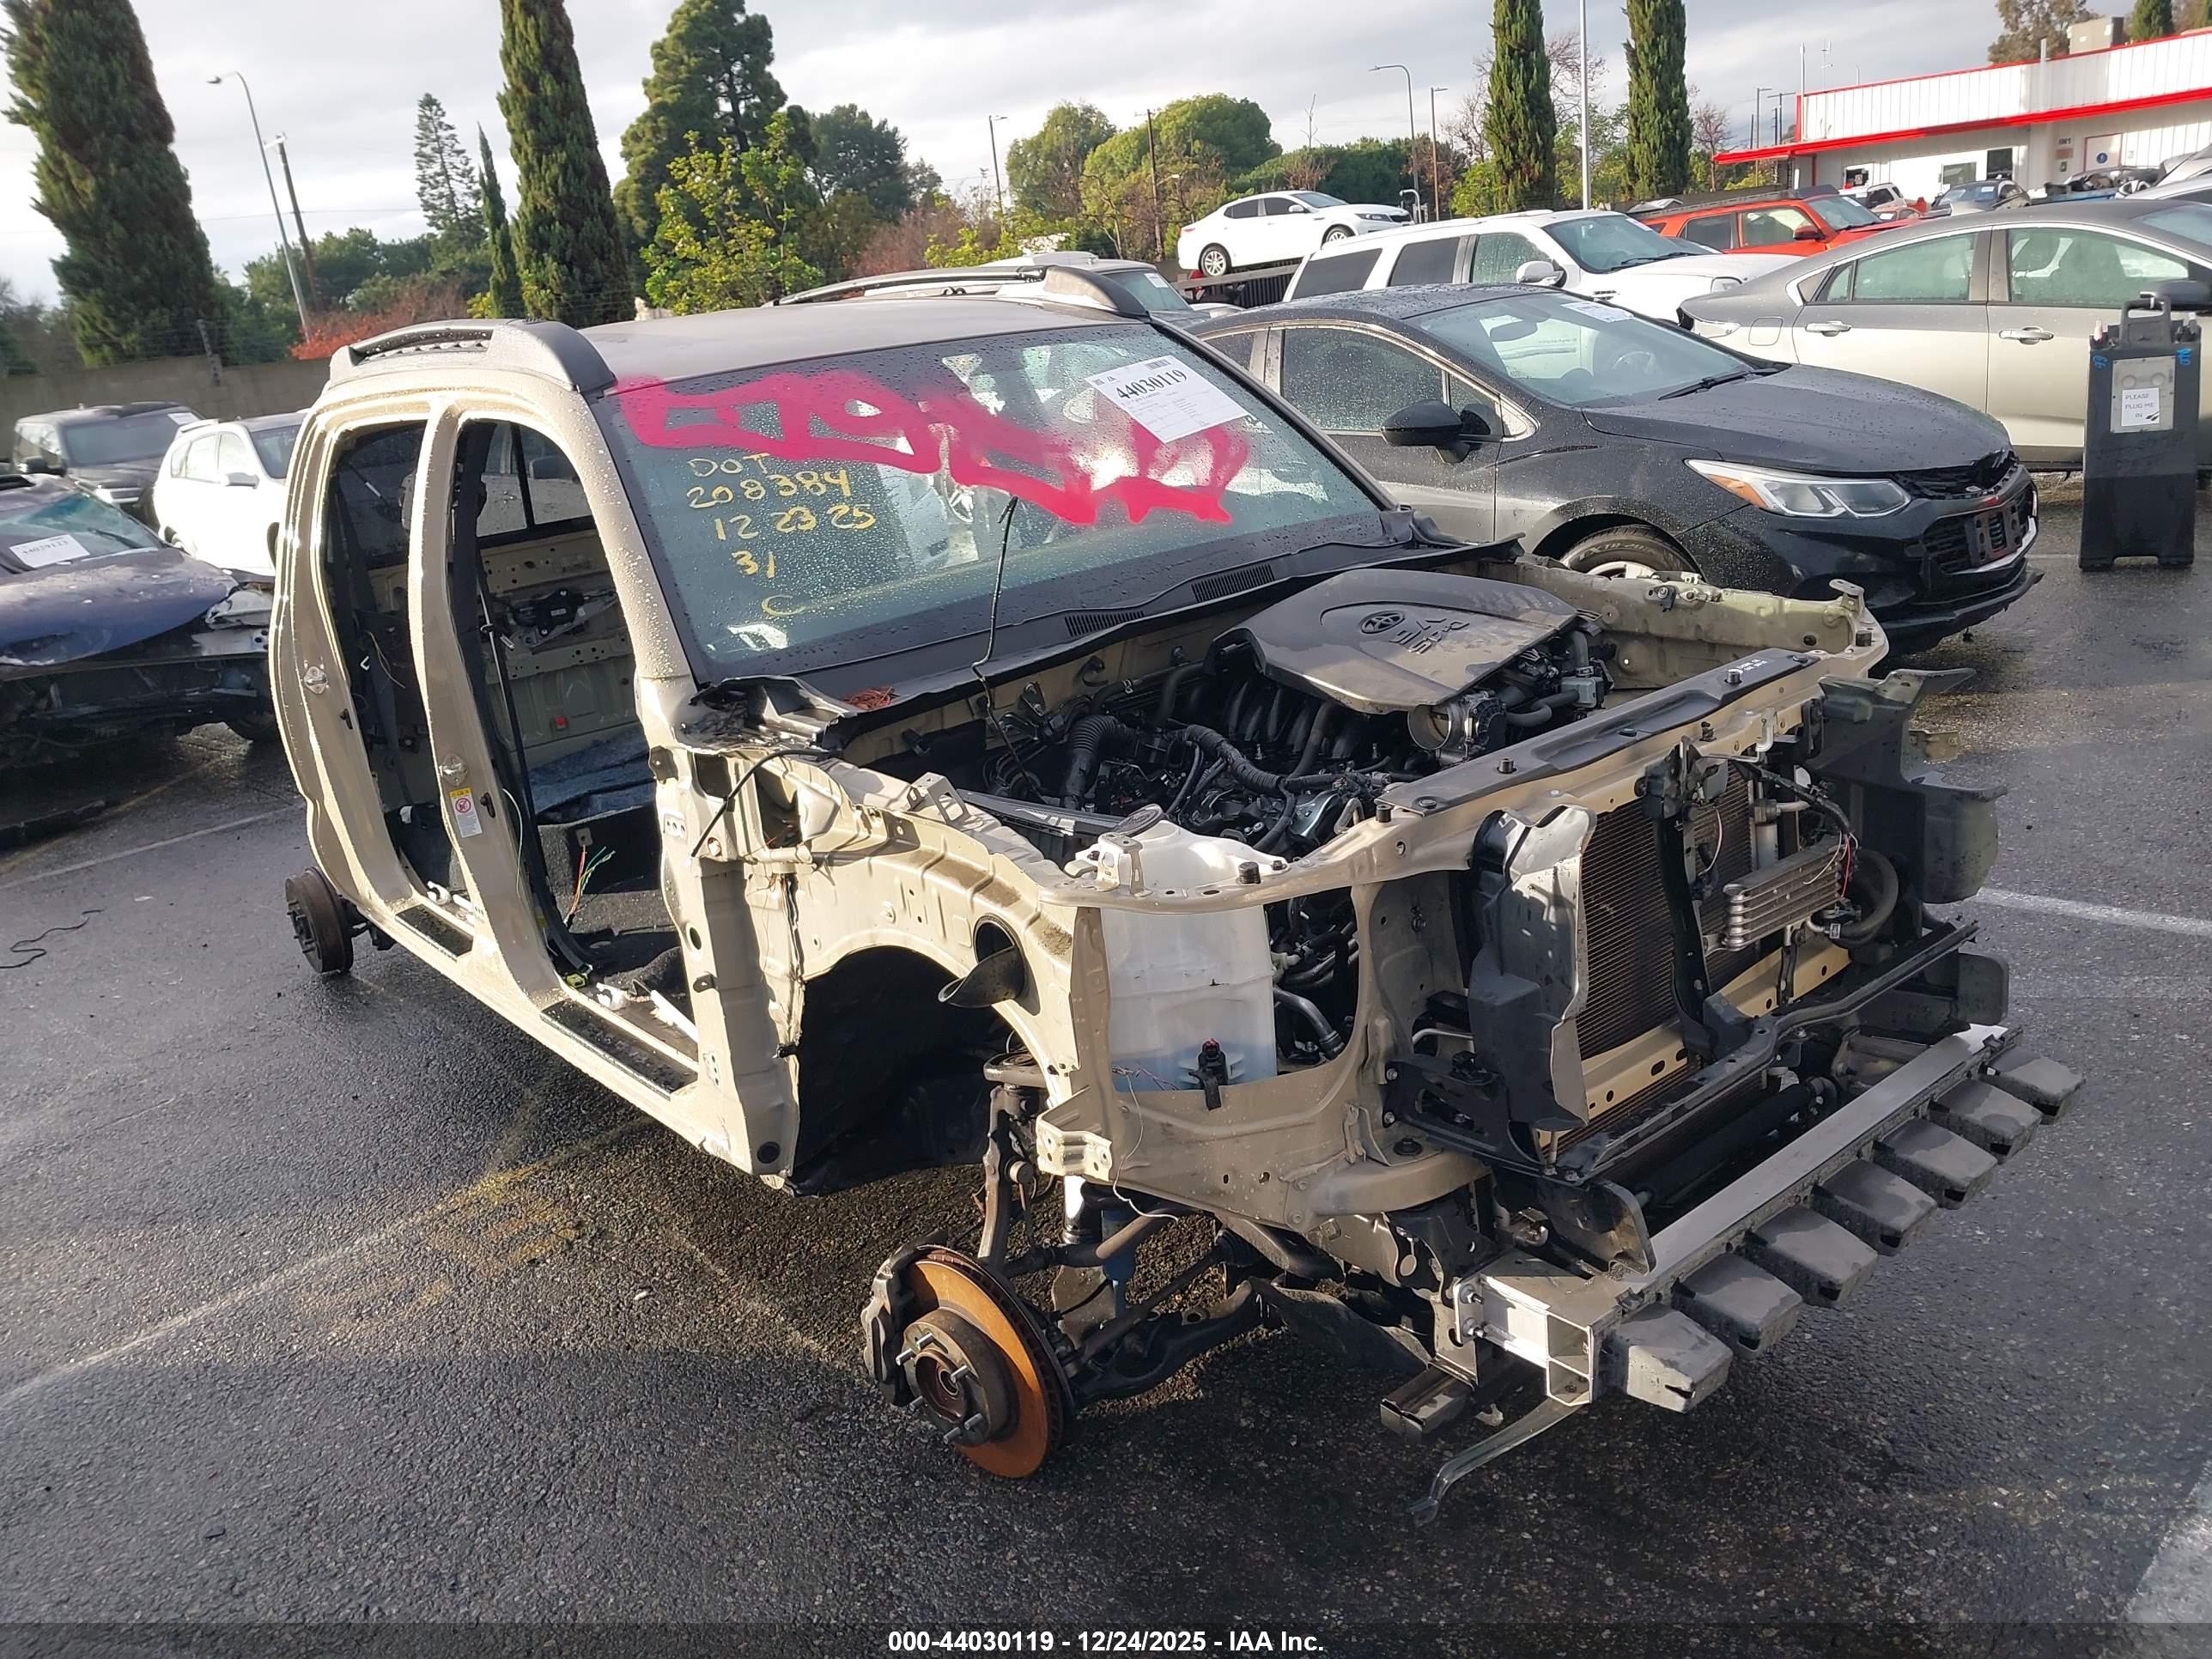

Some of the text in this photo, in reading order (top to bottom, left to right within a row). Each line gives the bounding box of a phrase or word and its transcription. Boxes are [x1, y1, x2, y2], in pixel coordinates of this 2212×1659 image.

[1115, 369, 1188, 400] 44030119
[688, 453, 770, 477] DOT
[686, 470, 852, 509] 208384
[714, 503, 877, 541] 12 23 25
[731, 550, 775, 579] 31
